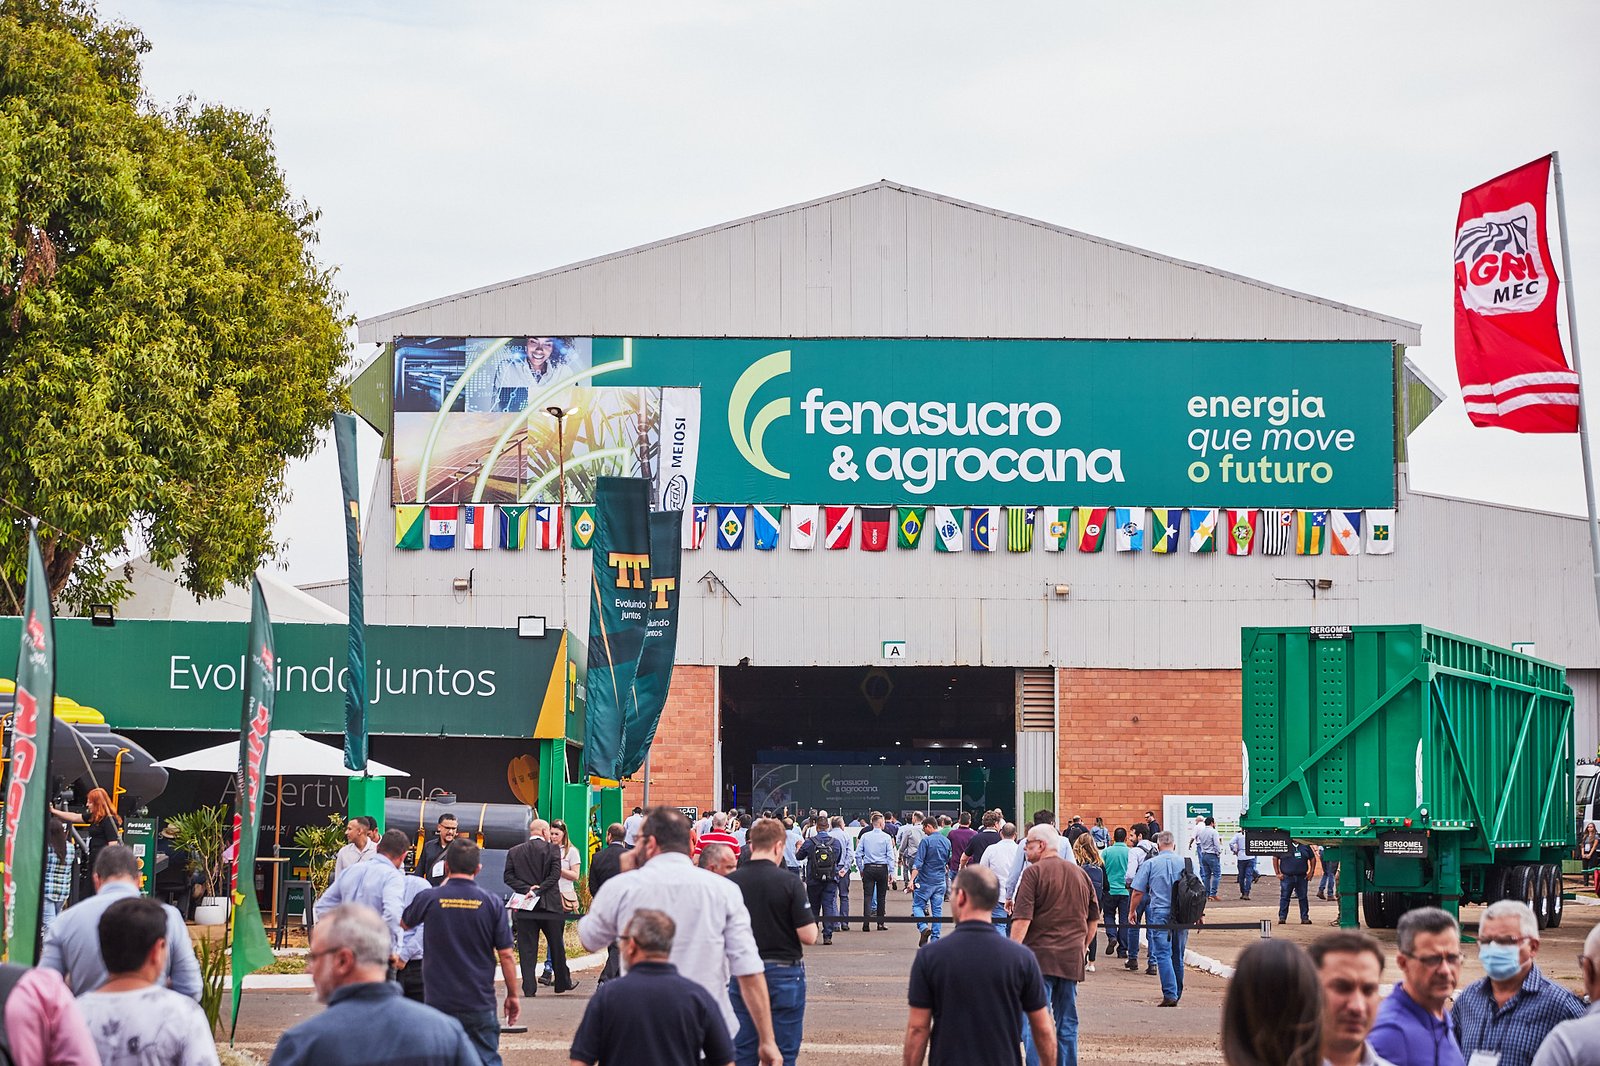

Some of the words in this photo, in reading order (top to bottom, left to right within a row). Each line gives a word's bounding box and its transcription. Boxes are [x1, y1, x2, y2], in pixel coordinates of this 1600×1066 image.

[1493, 281, 1539, 304] MEC
[800, 387, 1061, 436] fenasucro
[1187, 389, 1326, 426] energia
[671, 418, 686, 468] MEIOSI
[1187, 429, 1252, 457] que
[1261, 429, 1355, 451] move
[828, 445, 858, 482] &
[865, 446, 1125, 494] agrocana
[1187, 461, 1210, 483] o
[1219, 454, 1333, 484] futuro
[615, 598, 647, 609] Evoluindo
[620, 610, 642, 620] juntos
[1310, 626, 1353, 634] SERGOMEL
[890, 646, 900, 656] A
[169, 655, 349, 692] Evolindo
[370, 660, 496, 704] juntos
[840, 786, 878, 794] agrocana
